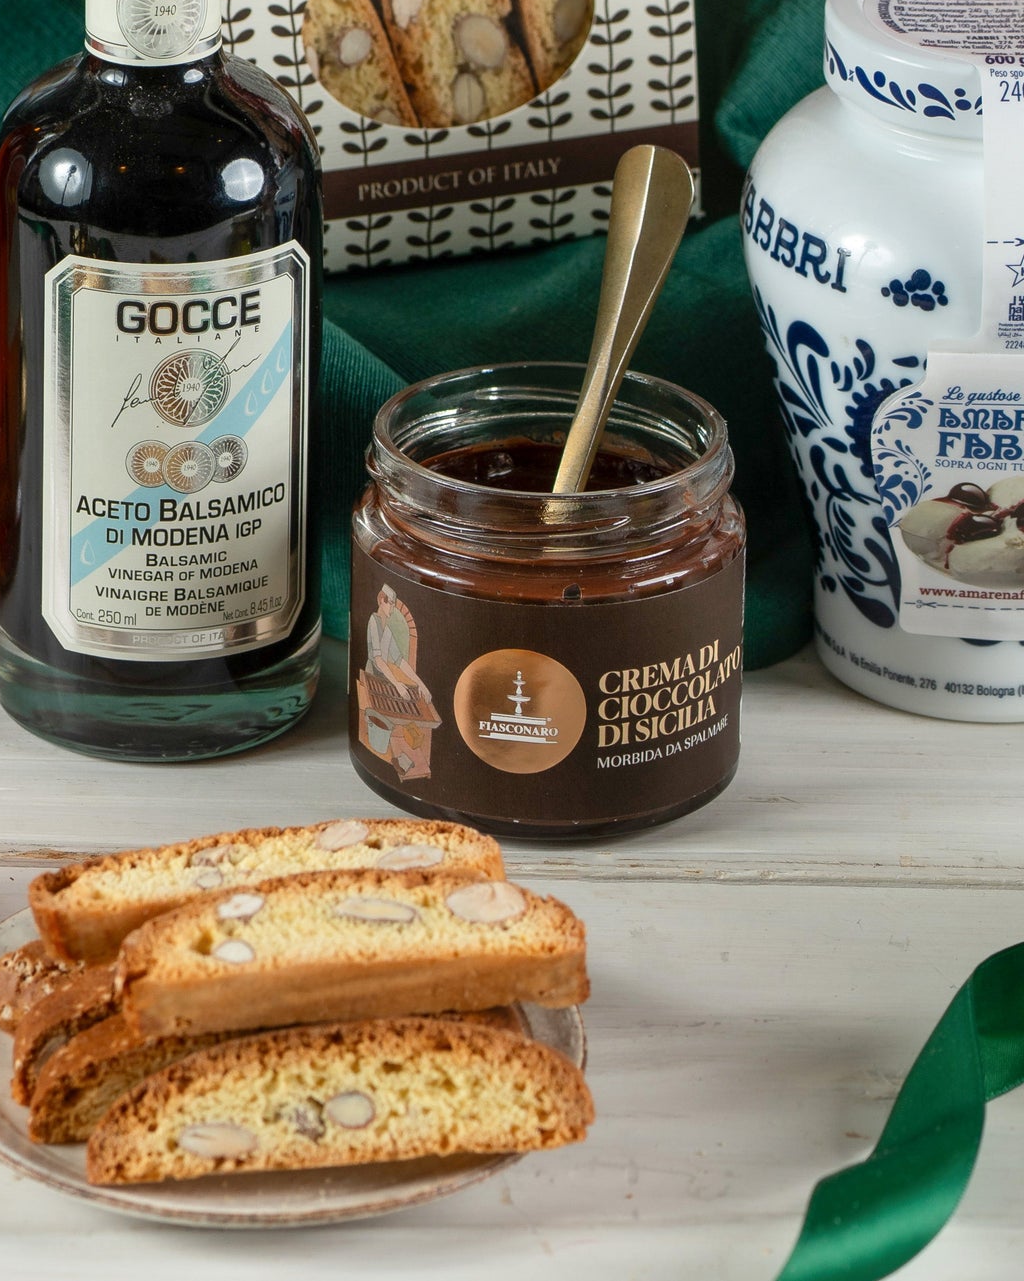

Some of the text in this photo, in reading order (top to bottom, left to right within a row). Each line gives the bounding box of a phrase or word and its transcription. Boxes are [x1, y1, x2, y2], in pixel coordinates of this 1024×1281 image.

[154, 4, 177, 17] 1940
[985, 56, 1015, 64] 600
[989, 68, 1008, 78] Peso
[999, 80, 1024, 102] 24
[358, 156, 561, 202] PRODUCT OF ITALY
[740, 173, 853, 293] ABBRI
[116, 289, 262, 336] GOCCE
[116, 325, 261, 345] ITALIANE
[181, 382, 201, 394] 1940
[942, 386, 1021, 406] Le gustose
[936, 431, 1024, 461] FAB
[935, 459, 973, 469] SOPRA
[976, 461, 1008, 471] OGNI
[76, 482, 286, 522] ACETO BALSAMICO
[106, 519, 263, 547] DI MODENA IGP
[146, 551, 228, 567] BALSAMIC
[108, 559, 259, 582] VINEGAR OF MODENA
[95, 575, 269, 602] VINAIGRE BALSAMIQUE
[76, 609, 137, 626] Cont. 250 ml
[145, 600, 226, 617] DE MODÈNE
[250, 601, 269, 616] 8.45
[191, 633, 206, 644] OF
[598, 639, 720, 695] CREMA DI
[597, 645, 742, 721] CIOCCOLATO
[919, 677, 937, 691] 276
[944, 682, 974, 696] 40132
[976, 685, 1015, 699] Bologna
[478, 720, 559, 737] FIASCONARO
[597, 694, 717, 748] DI SICILIA
[596, 713, 729, 769] MORBIDA DA SPALMARE
